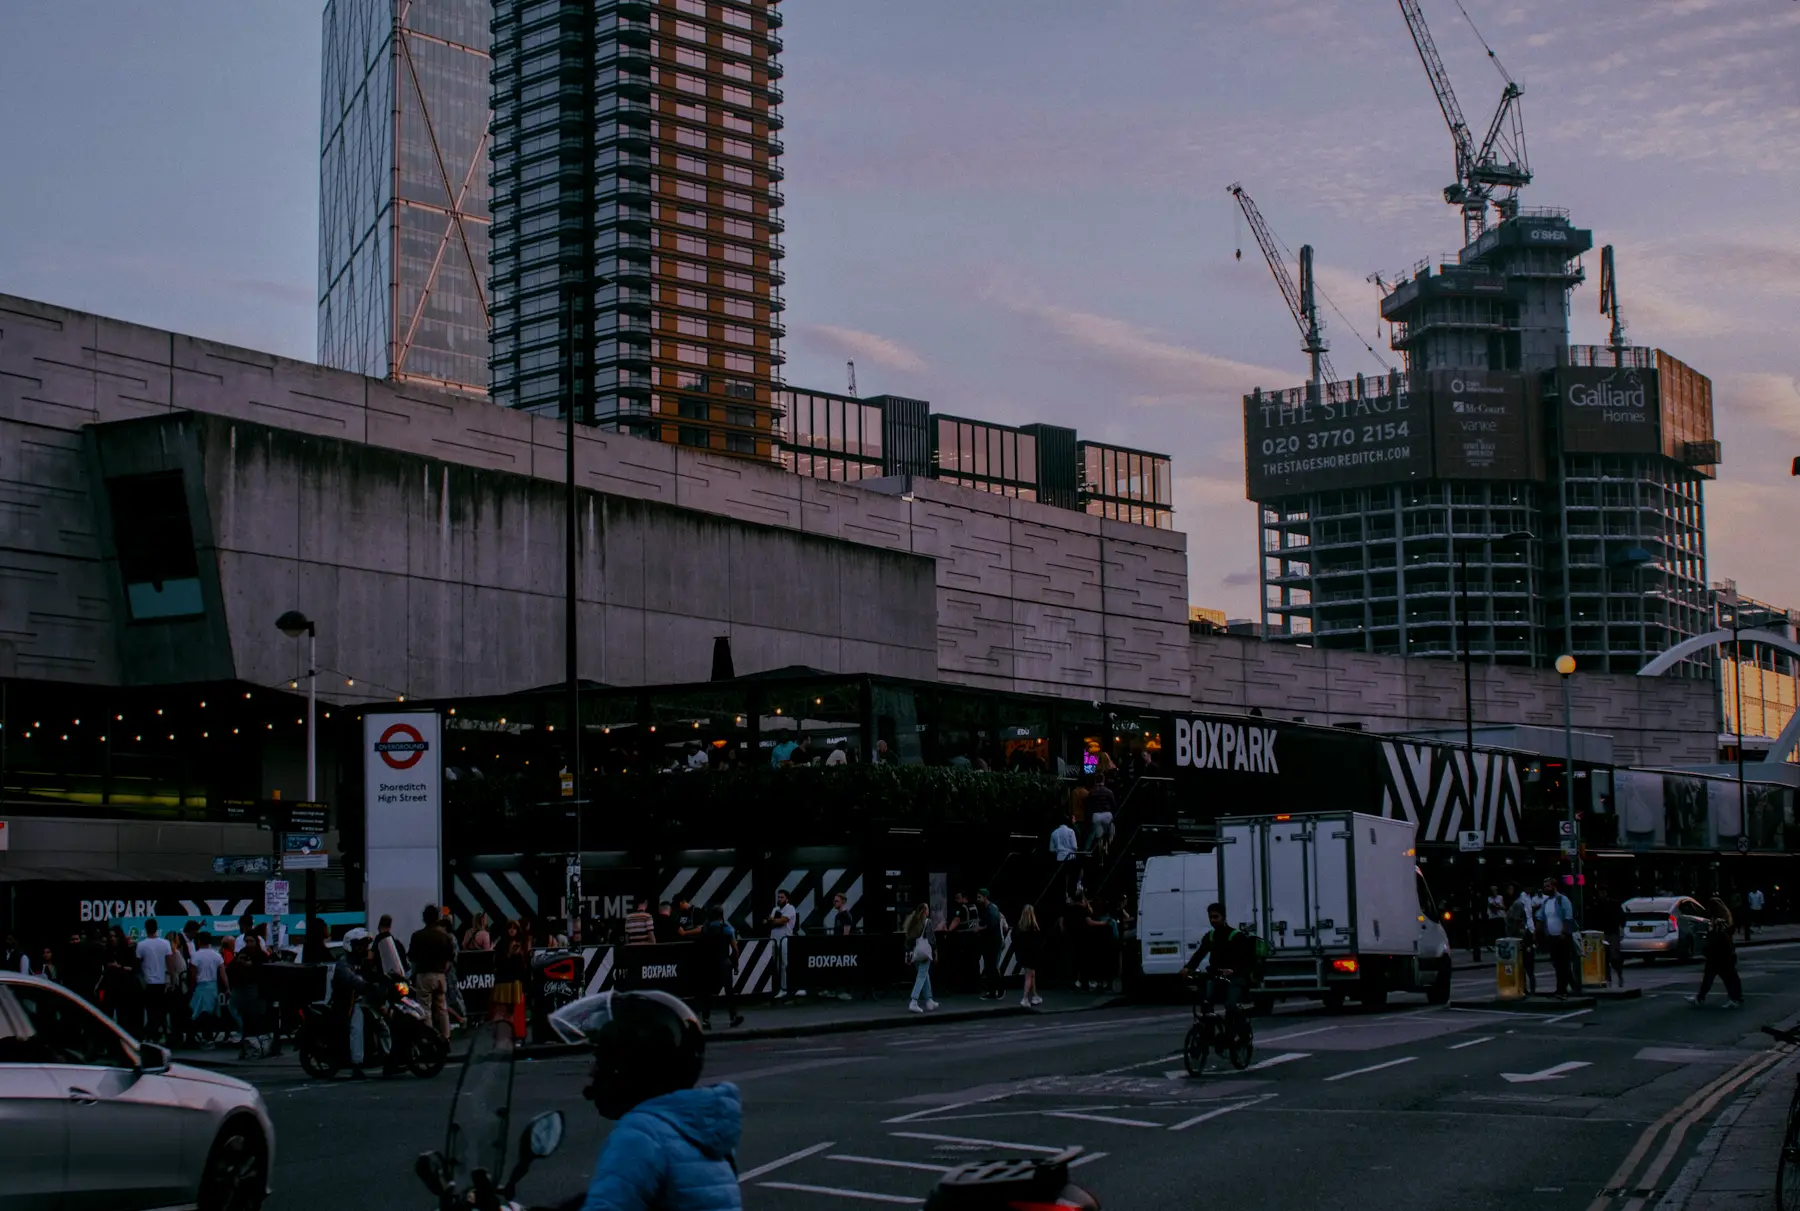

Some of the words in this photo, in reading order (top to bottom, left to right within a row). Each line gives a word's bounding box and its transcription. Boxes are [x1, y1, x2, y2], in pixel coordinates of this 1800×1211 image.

[1531, 228, 1567, 240] O'SHEA
[1569, 383, 1645, 407] Galliard
[1260, 400, 1315, 428] THE
[1323, 387, 1410, 421] STAGE
[1465, 403, 1506, 414] McCourt
[1602, 408, 1646, 422] Homes
[1262, 435, 1300, 456] 020
[1306, 428, 1355, 449] 3770
[1362, 420, 1410, 442] 2154
[1262, 446, 1410, 476] THESTAGESHOREDITCH.COM
[378, 743, 425, 751] OVERGROUND
[1175, 718, 1280, 774] BOXPARK
[379, 783, 427, 792] Shoreditch
[377, 795, 398, 804] High
[400, 794, 427, 802] Street
[79, 900, 157, 922] BOXPARK
[603, 894, 635, 919] ME
[808, 954, 858, 968] BOXPARK
[641, 963, 679, 980] BOXPARK
[457, 973, 496, 989] OXPAR
